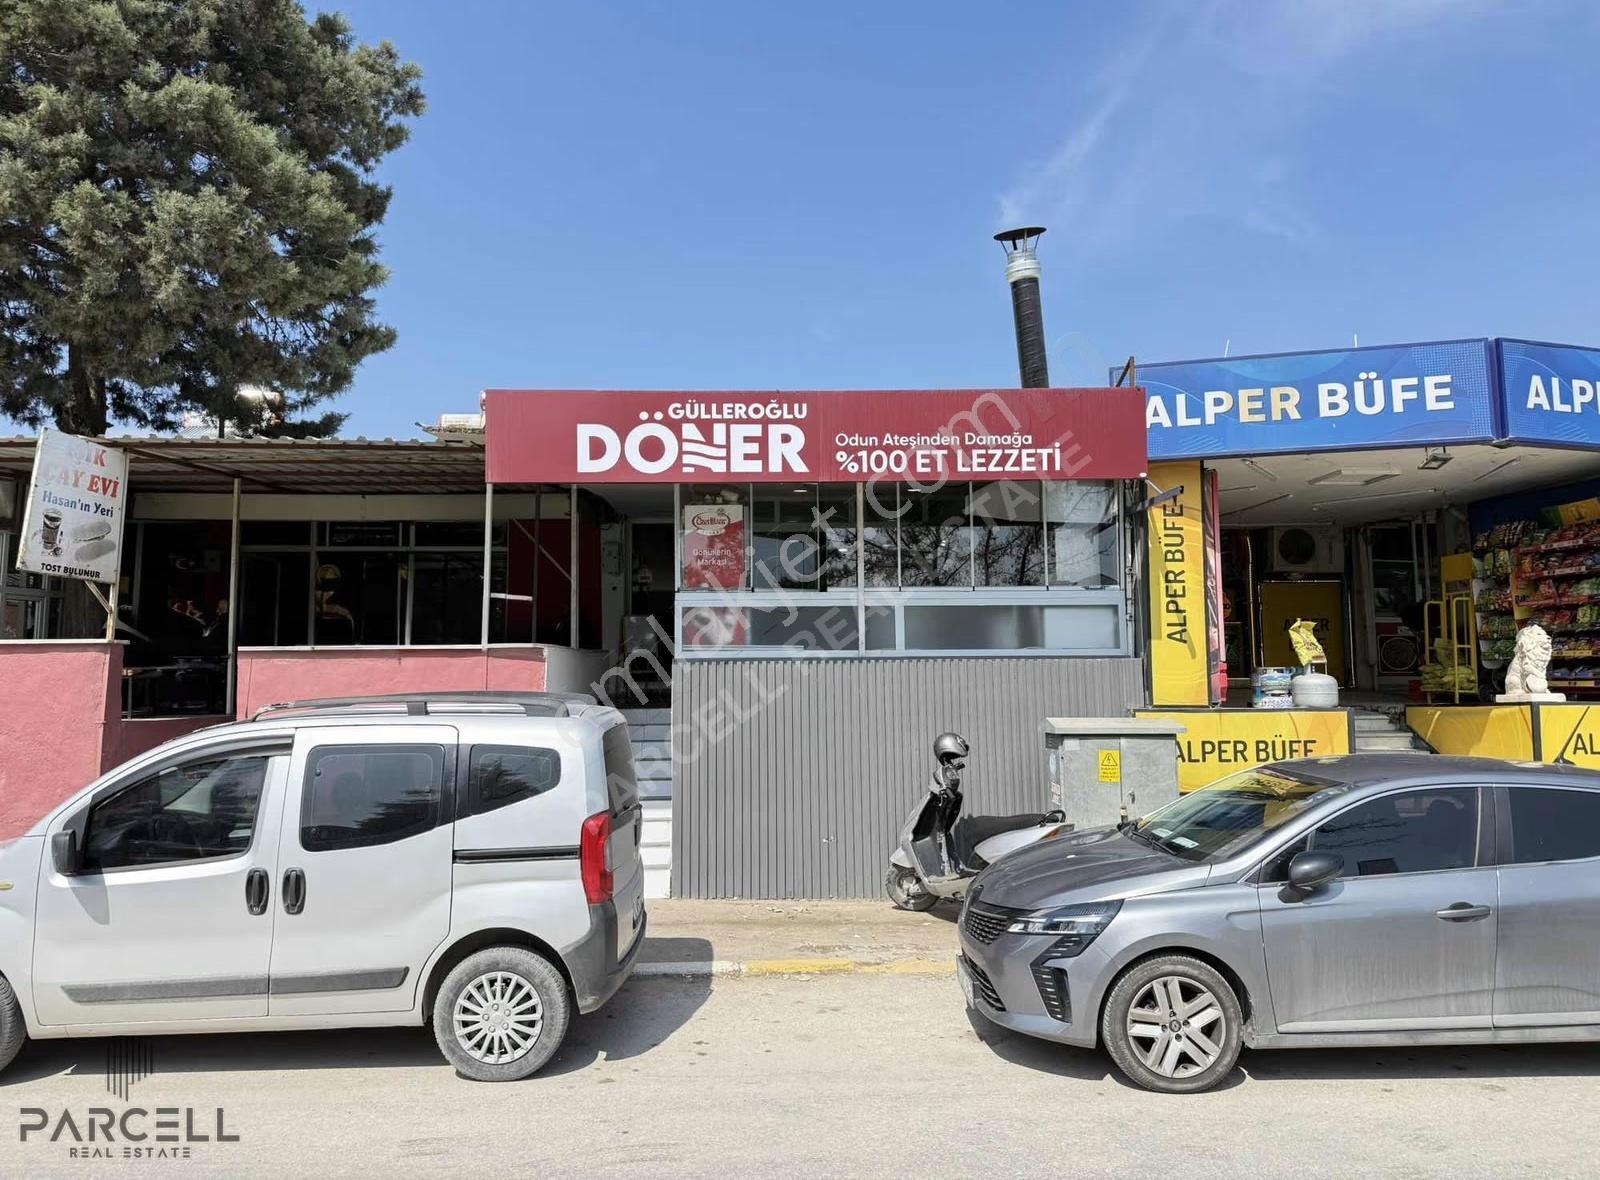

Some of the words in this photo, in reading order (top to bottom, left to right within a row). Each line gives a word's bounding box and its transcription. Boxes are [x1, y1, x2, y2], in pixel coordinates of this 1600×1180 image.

[1146, 385, 1302, 429] ALPER
[1317, 370, 1455, 418] BÜFE
[1526, 374, 1600, 415] ALP
[667, 399, 808, 420] GÜLLEROĞLU
[576, 410, 810, 475] DÖNER
[835, 432, 879, 447] Odun
[882, 432, 960, 449] Ateşinden
[964, 431, 1033, 448] Damağa
[835, 449, 908, 474] %100
[915, 449, 948, 473] ET
[956, 441, 1062, 473] LEZZETİ
[87, 474, 120, 498] EVİ
[93, 501, 114, 518] Yeri
[1158, 503, 1185, 563] BÜFE
[41, 562, 61, 573] TOST
[63, 564, 101, 578] BULUNUR
[1164, 569, 1188, 645] ALPER
[1175, 739, 1249, 763] ALPER
